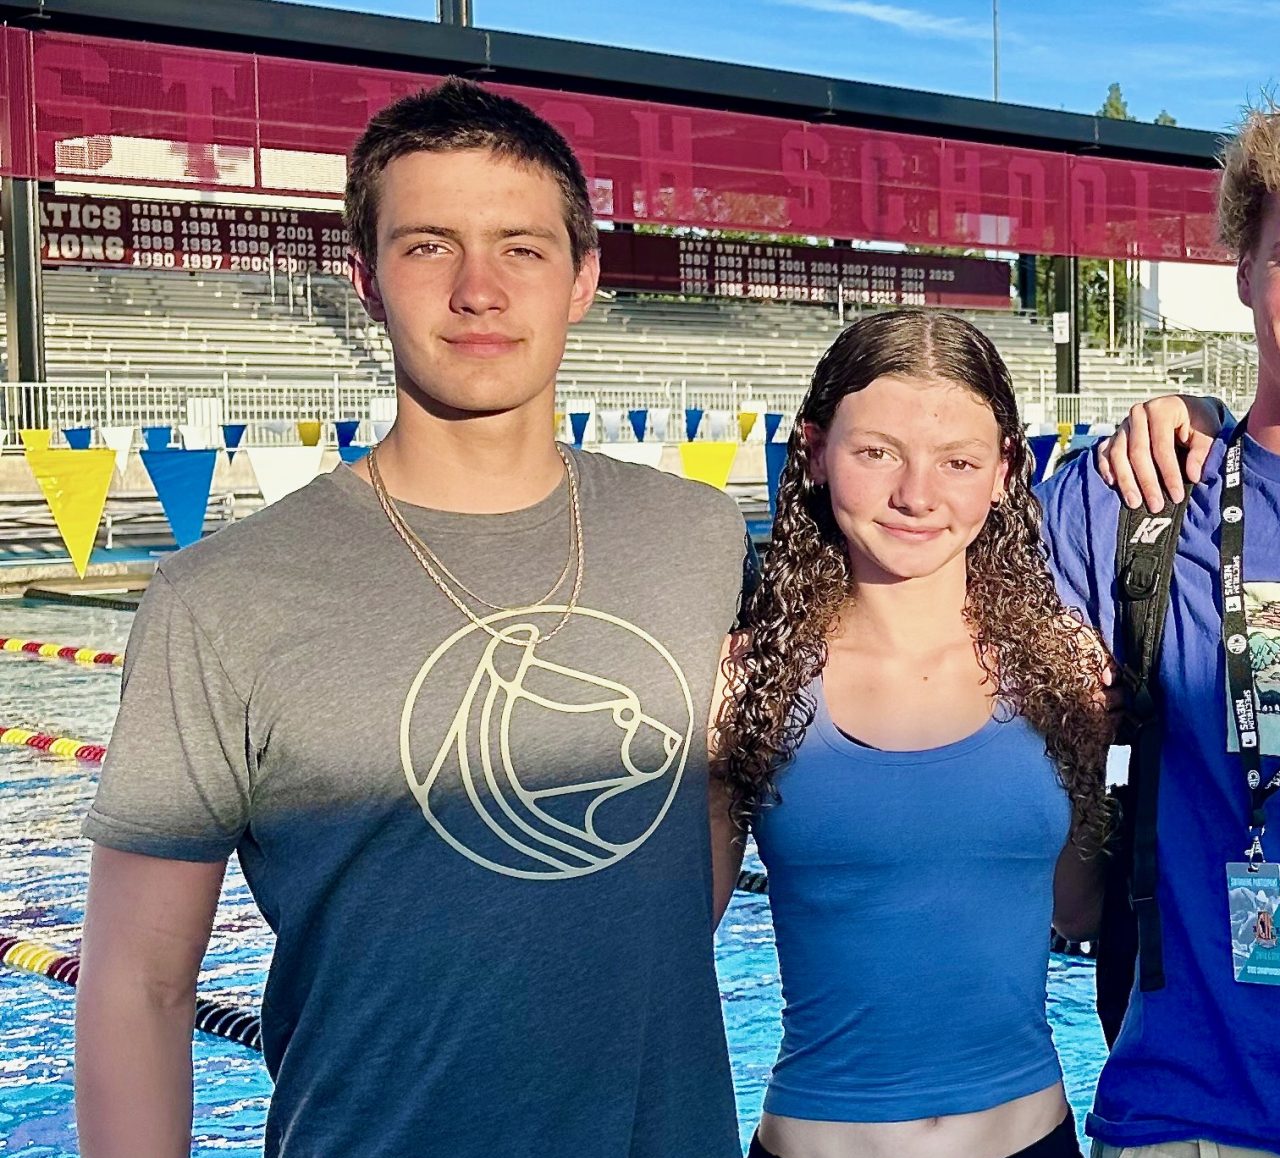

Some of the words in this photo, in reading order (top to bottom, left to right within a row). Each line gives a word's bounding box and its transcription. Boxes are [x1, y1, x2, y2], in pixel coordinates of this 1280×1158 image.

[181, 221, 219, 236] 1991
[276, 226, 313, 241] 2001
[322, 228, 350, 243] 200
[182, 237, 222, 252] 1992
[277, 242, 317, 257] 2002
[322, 245, 348, 260] 200
[133, 251, 175, 268] 1990
[182, 253, 223, 270] 1997
[322, 260, 348, 276] 200
[780, 259, 806, 272] 2001
[810, 261, 839, 275] 2004
[842, 263, 869, 276] 2007
[747, 283, 778, 298] 2000
[1235, 699, 1249, 731] NEWS
[1243, 689, 1255, 730] SPECTRUM
